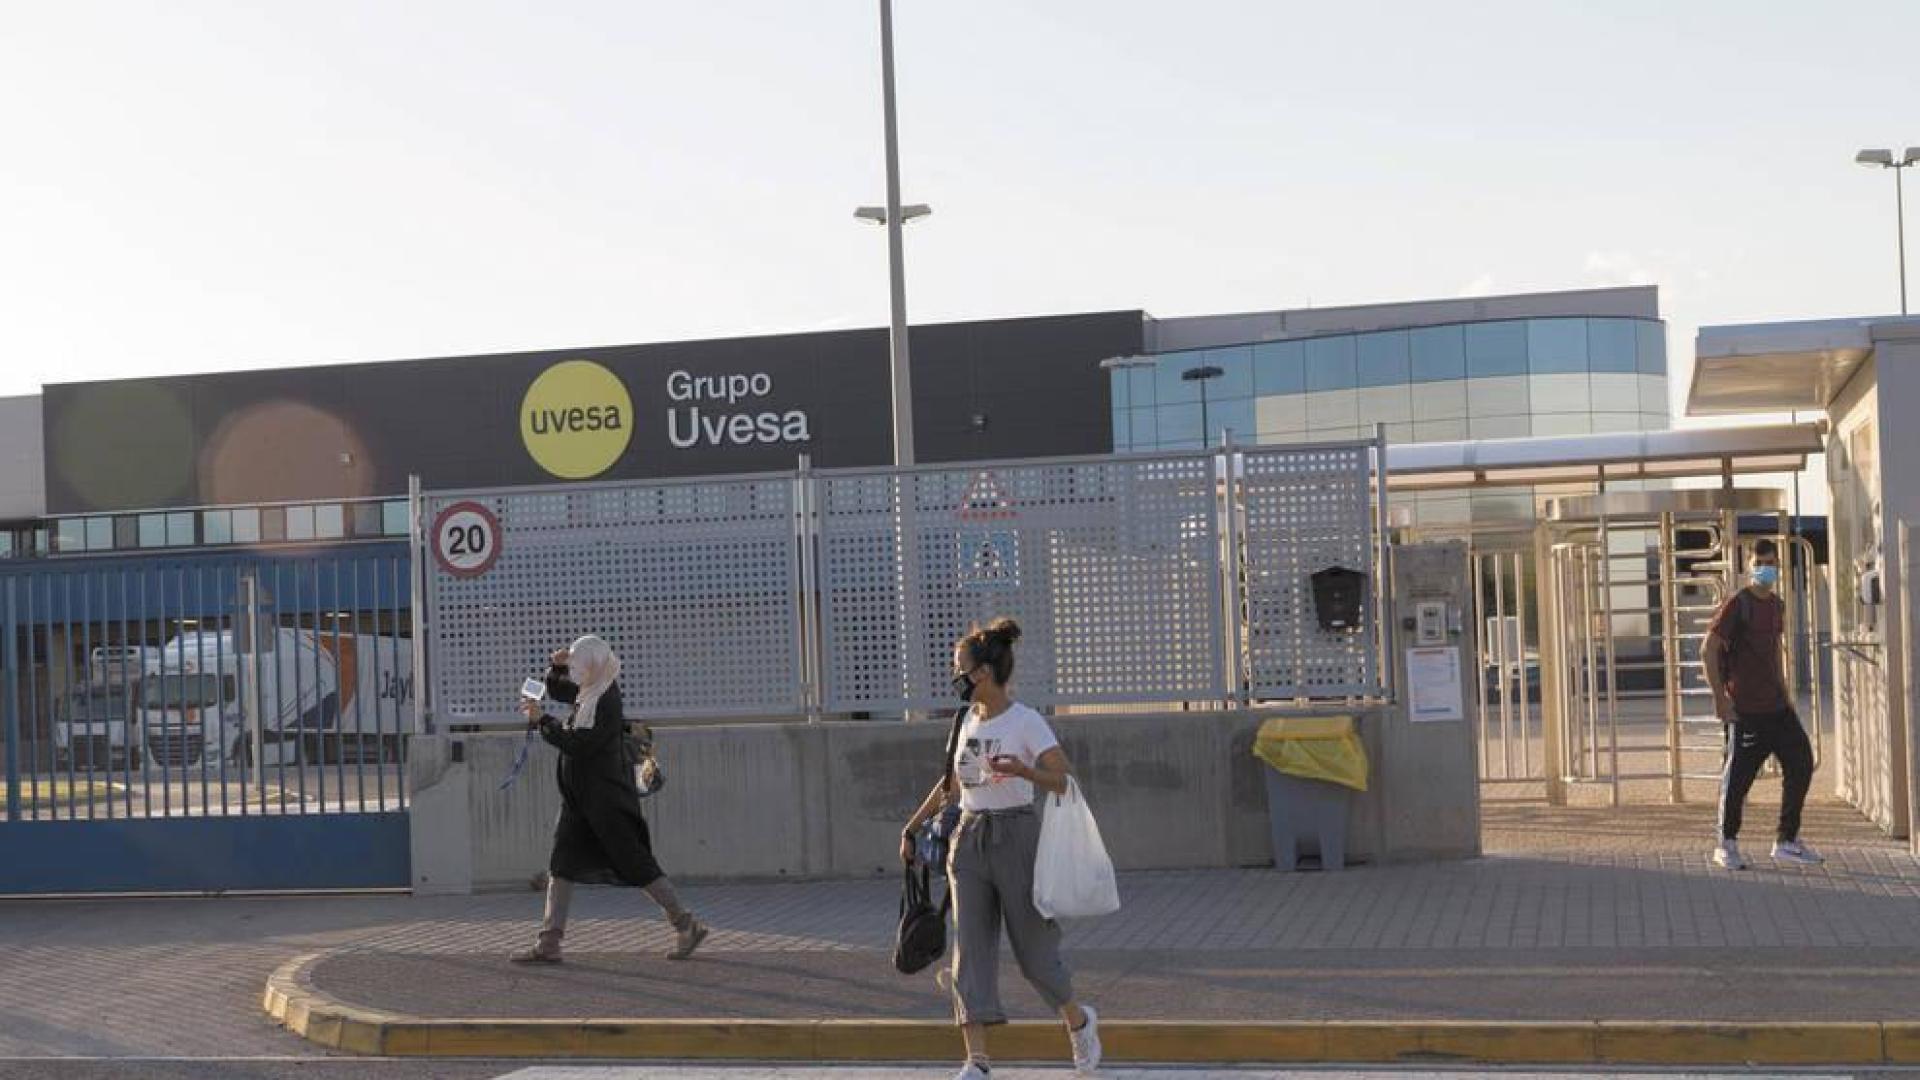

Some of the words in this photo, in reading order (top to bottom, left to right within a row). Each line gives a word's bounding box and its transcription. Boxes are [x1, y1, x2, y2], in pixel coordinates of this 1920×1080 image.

[666, 370, 771, 404] Grupo
[531, 405, 621, 434] uvesa
[667, 407, 811, 448] Uvesa
[449, 525, 485, 554] 20
